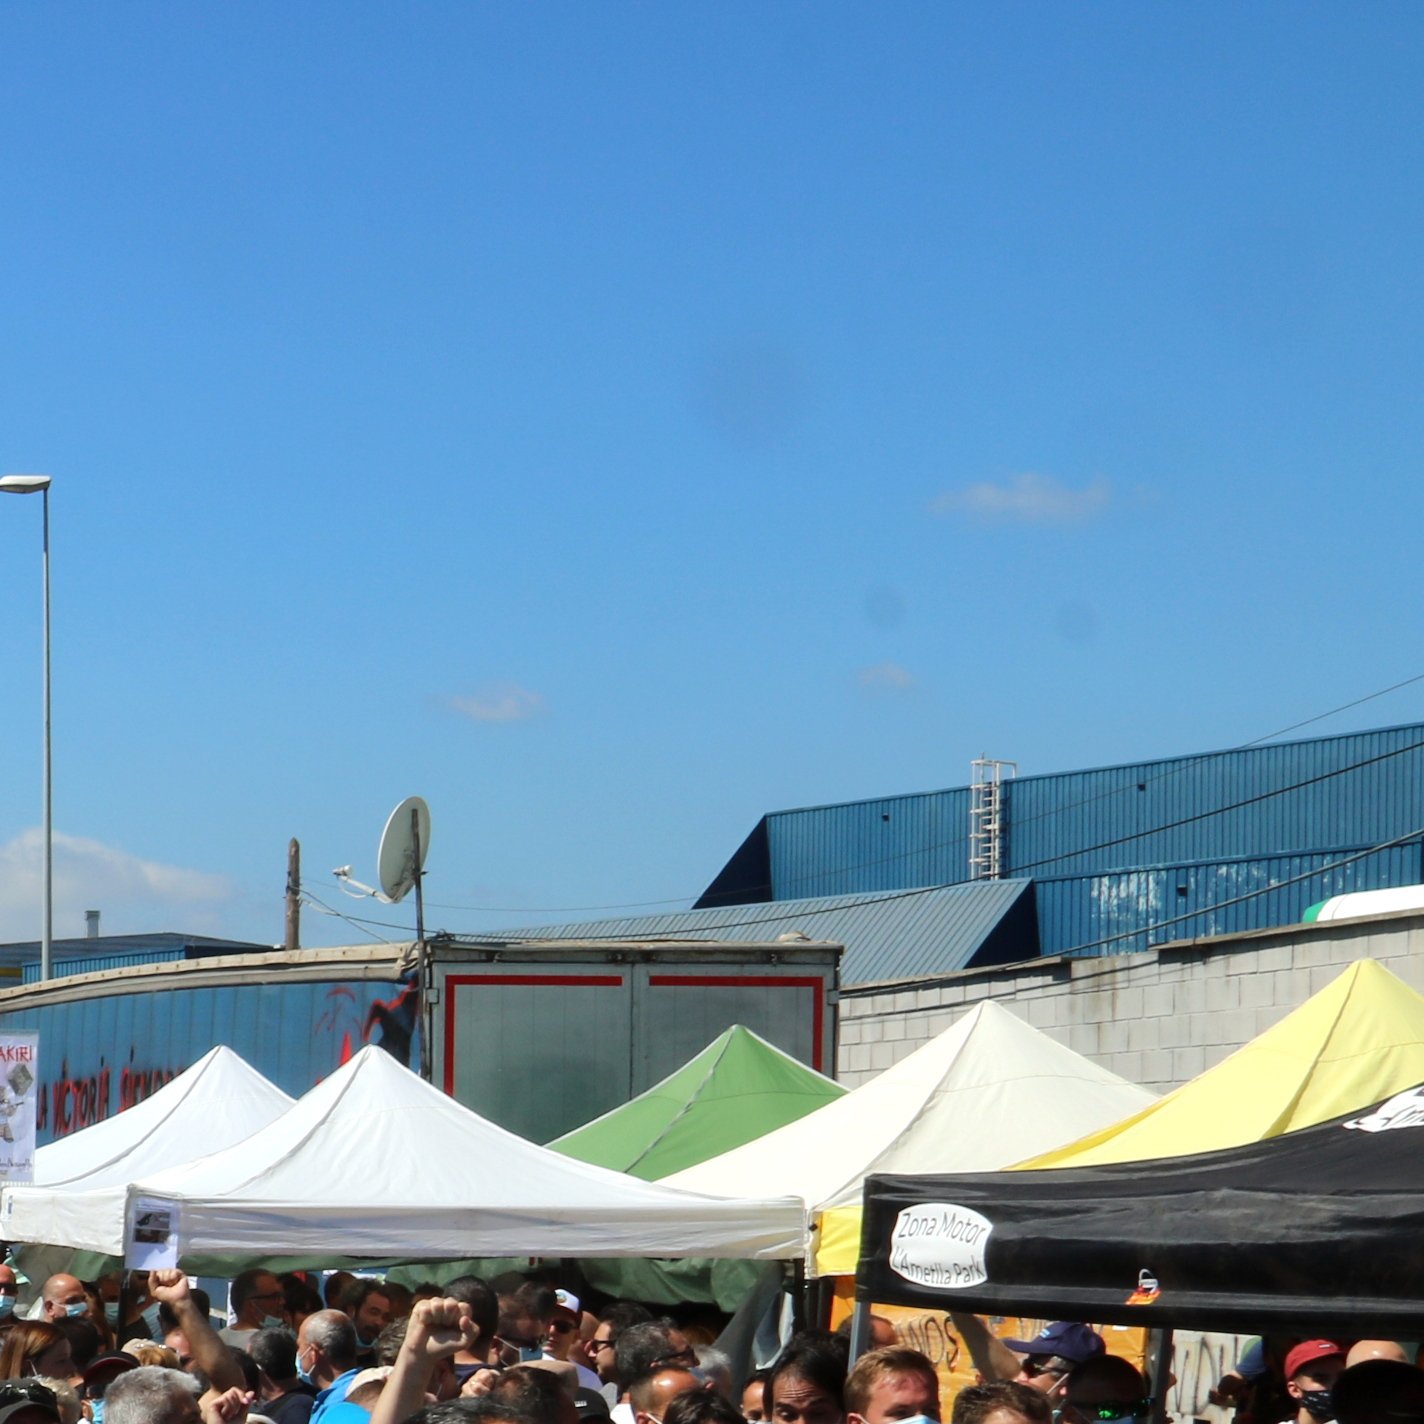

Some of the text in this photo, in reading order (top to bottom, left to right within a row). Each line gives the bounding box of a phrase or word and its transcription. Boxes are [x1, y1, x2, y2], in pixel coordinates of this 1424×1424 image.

[898, 1211, 987, 1246] Zona Motor
[953, 1254, 985, 1285] Park
